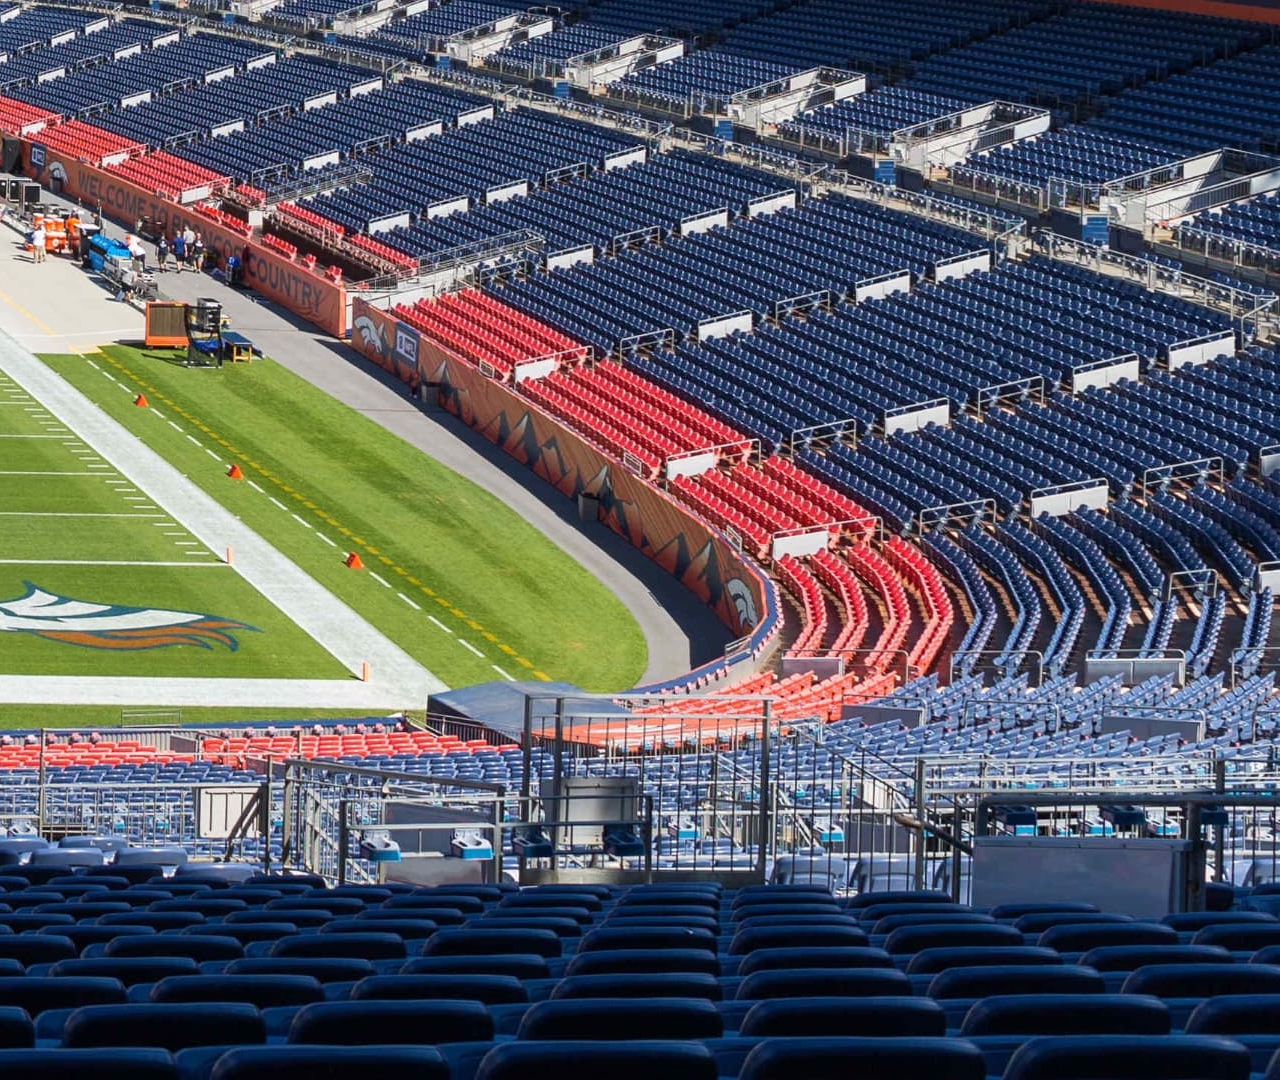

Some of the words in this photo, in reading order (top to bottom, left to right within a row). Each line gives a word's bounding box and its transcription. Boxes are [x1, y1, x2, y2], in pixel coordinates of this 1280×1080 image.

[78, 171, 147, 218] WELCOME
[150, 200, 170, 226] TO
[247, 252, 323, 314] COUNTRY
